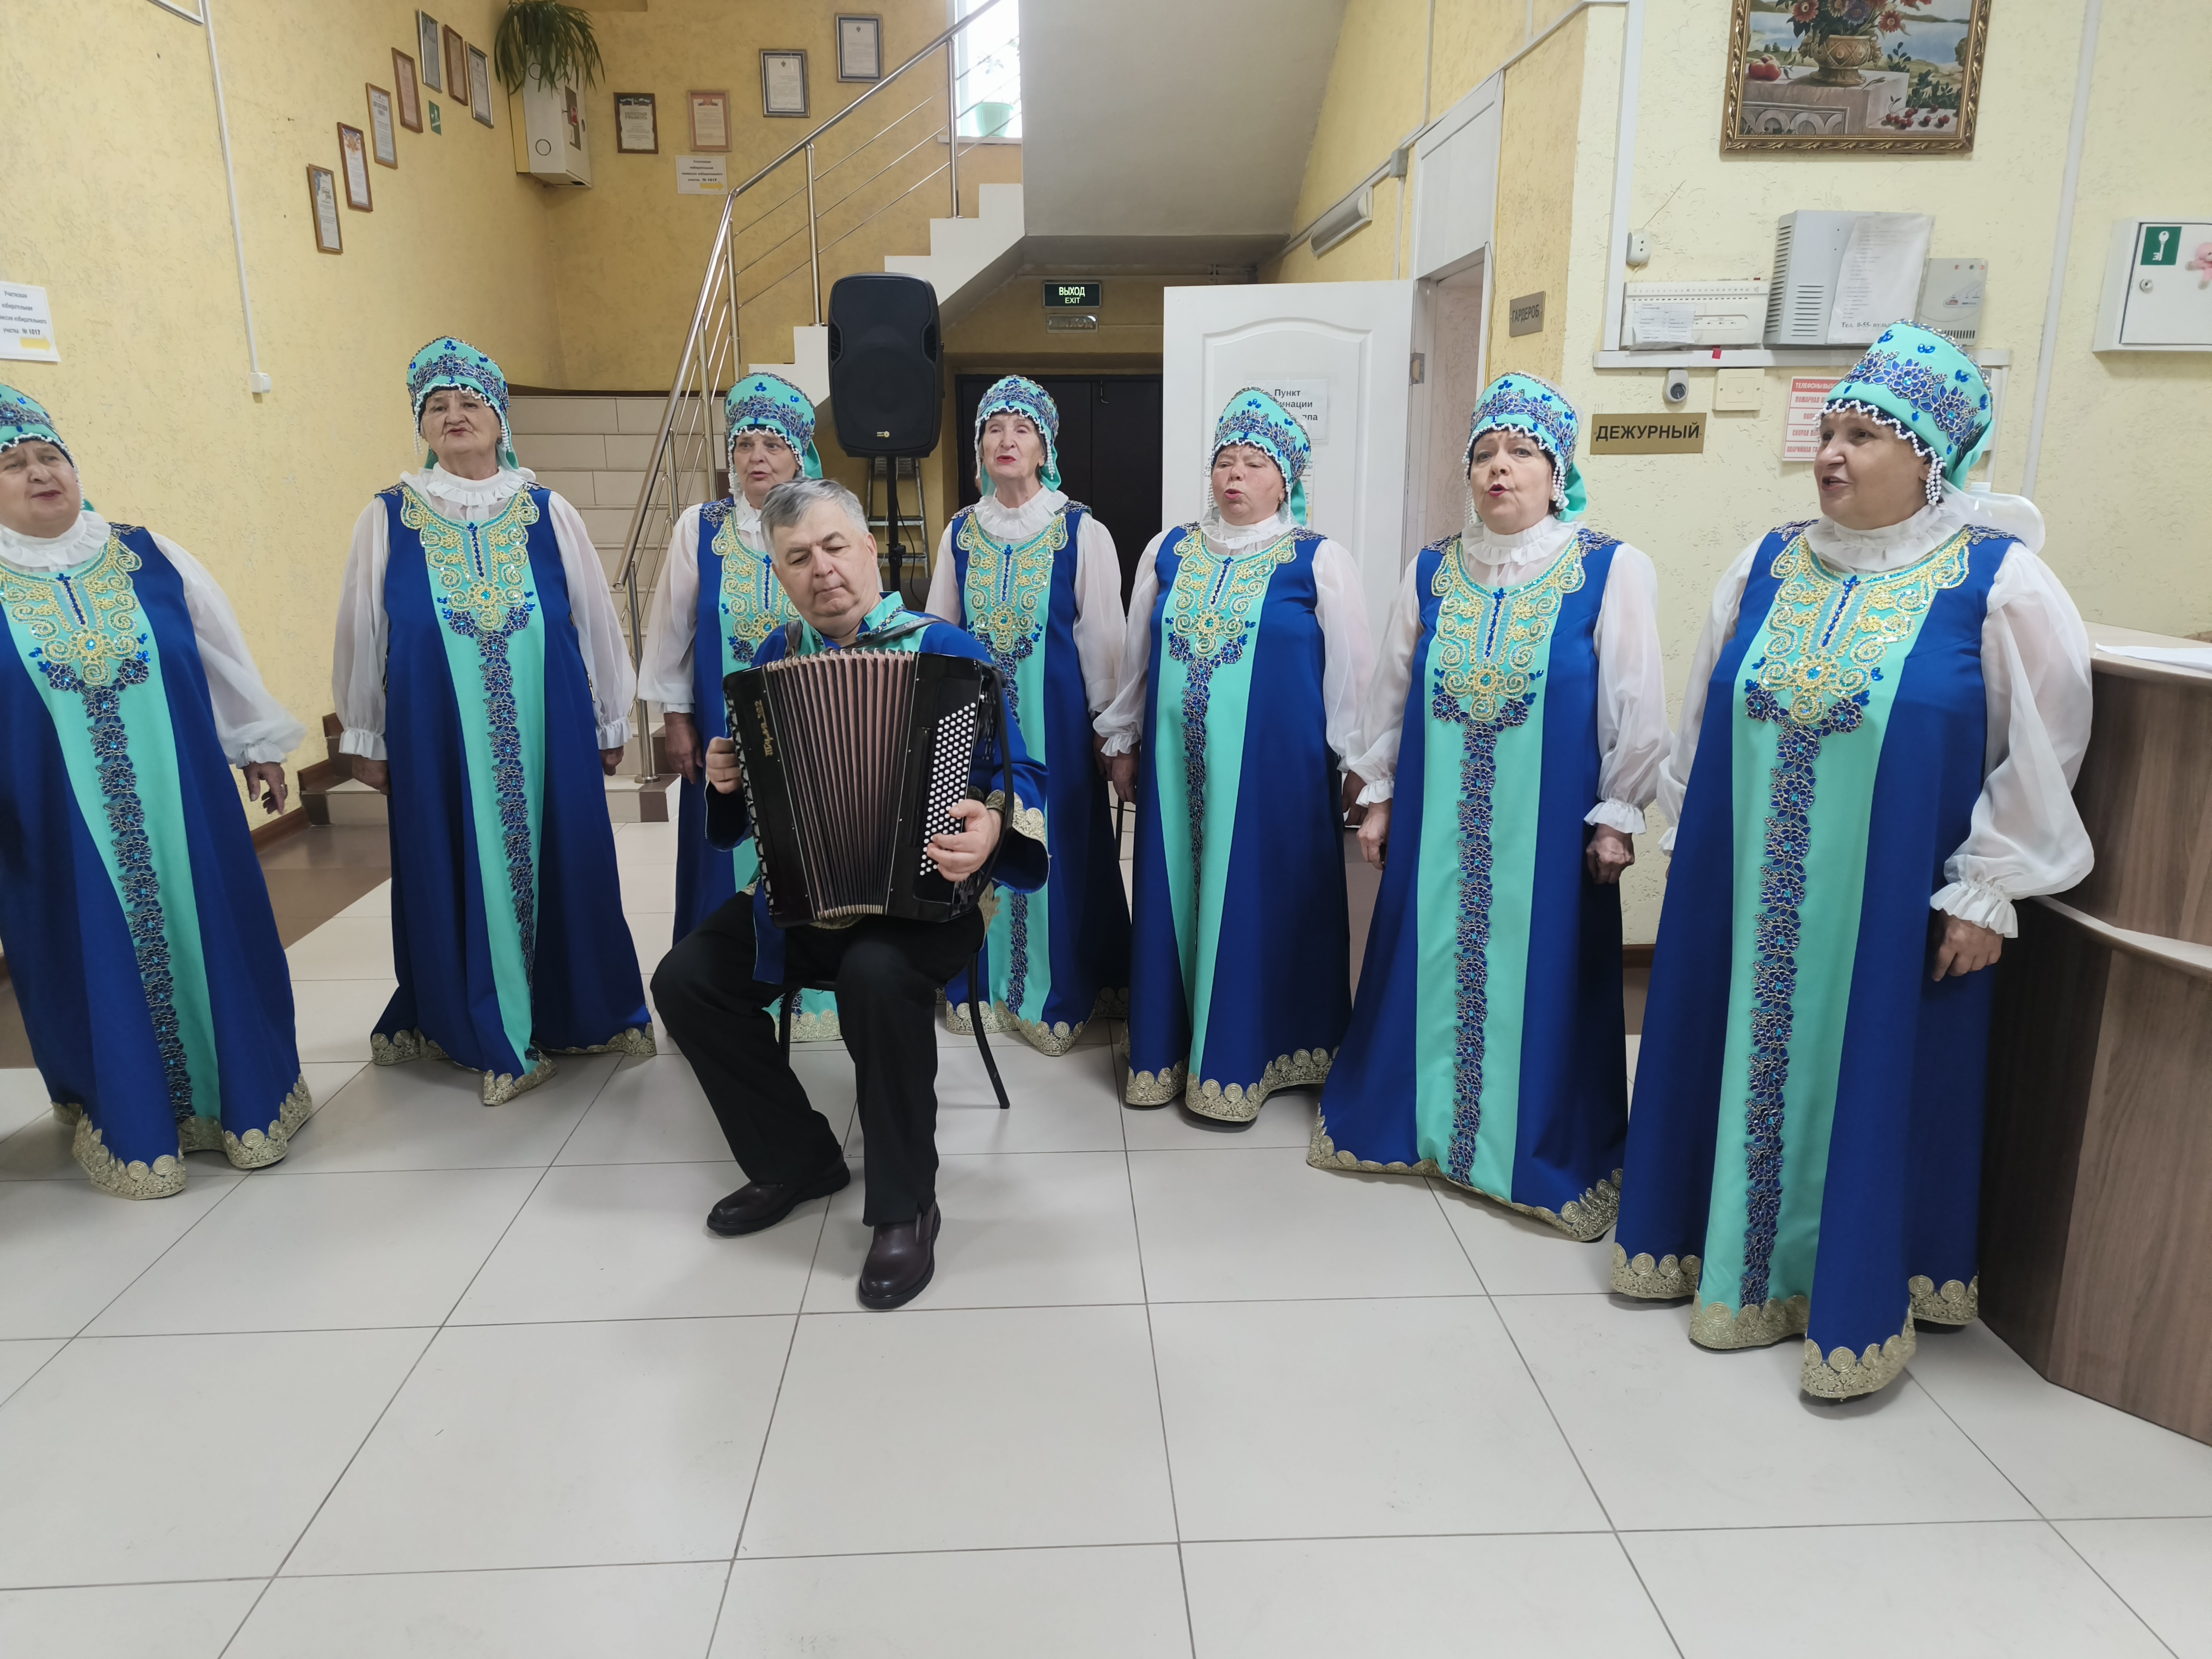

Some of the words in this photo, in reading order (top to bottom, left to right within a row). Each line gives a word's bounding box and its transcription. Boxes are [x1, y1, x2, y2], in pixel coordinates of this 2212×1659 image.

[1059, 286, 1086, 297] ВЫХОД
[1512, 304, 1539, 323] ГАРДЕРОБ
[1275, 389, 1301, 398] Пункт
[1596, 422, 1700, 442] ДЕЖУРНЫЙ
